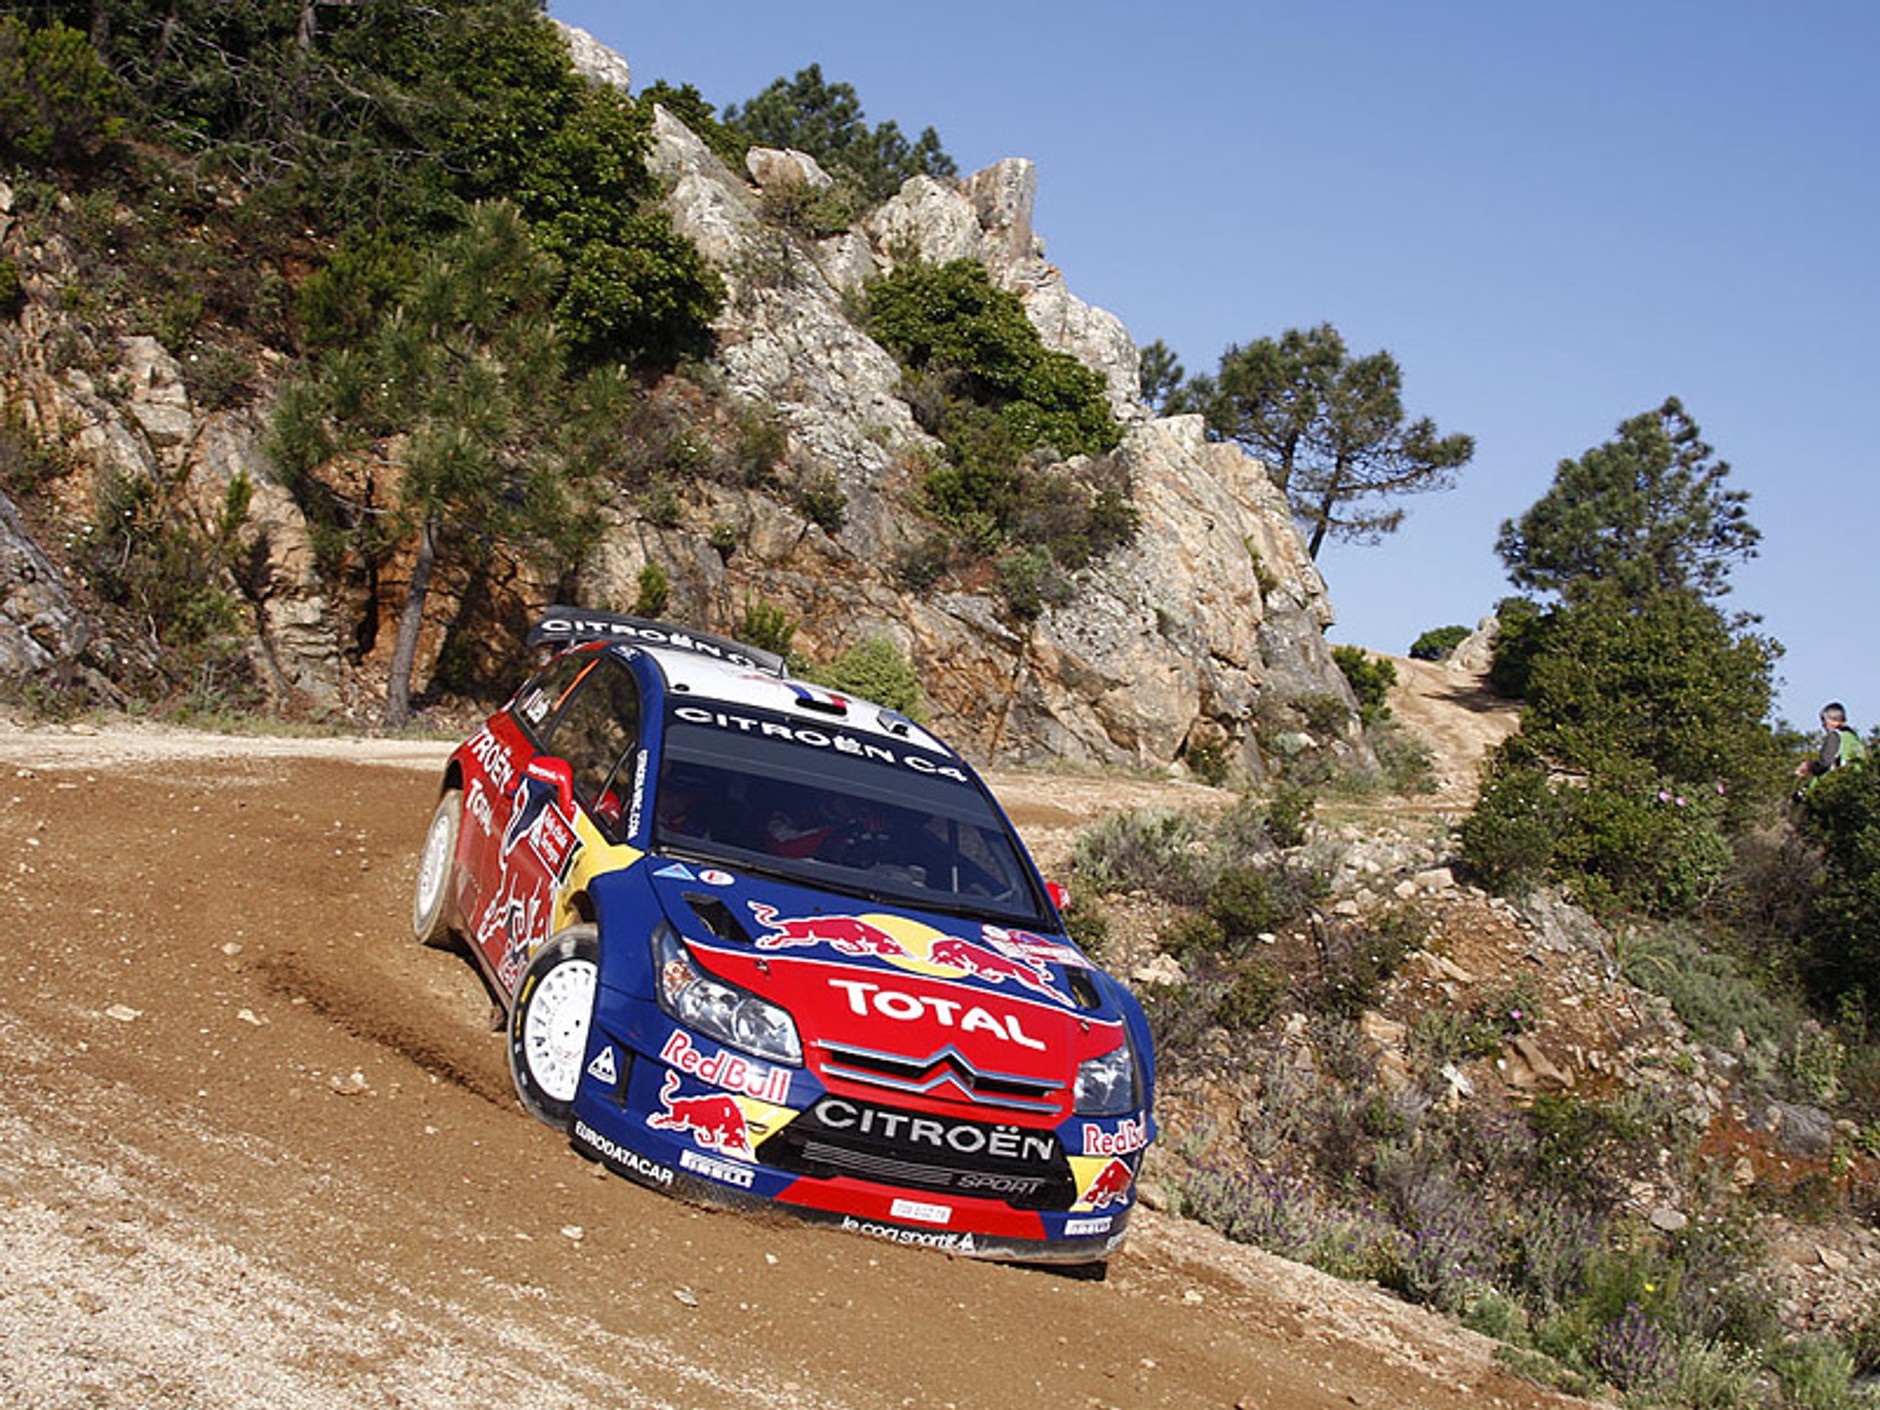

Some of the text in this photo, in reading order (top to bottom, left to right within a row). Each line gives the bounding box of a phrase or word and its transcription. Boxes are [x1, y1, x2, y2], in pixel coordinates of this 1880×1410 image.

[541, 619, 721, 658] CITROËN
[674, 706, 969, 783] CITROËN C4
[829, 979, 1047, 1051] TOTAL
[575, 1120, 674, 1186] EURODATACAR
[815, 1100, 1054, 1161] CITROËN
[957, 1174, 1044, 1195] SPORT
[860, 1221, 899, 1243] coq
